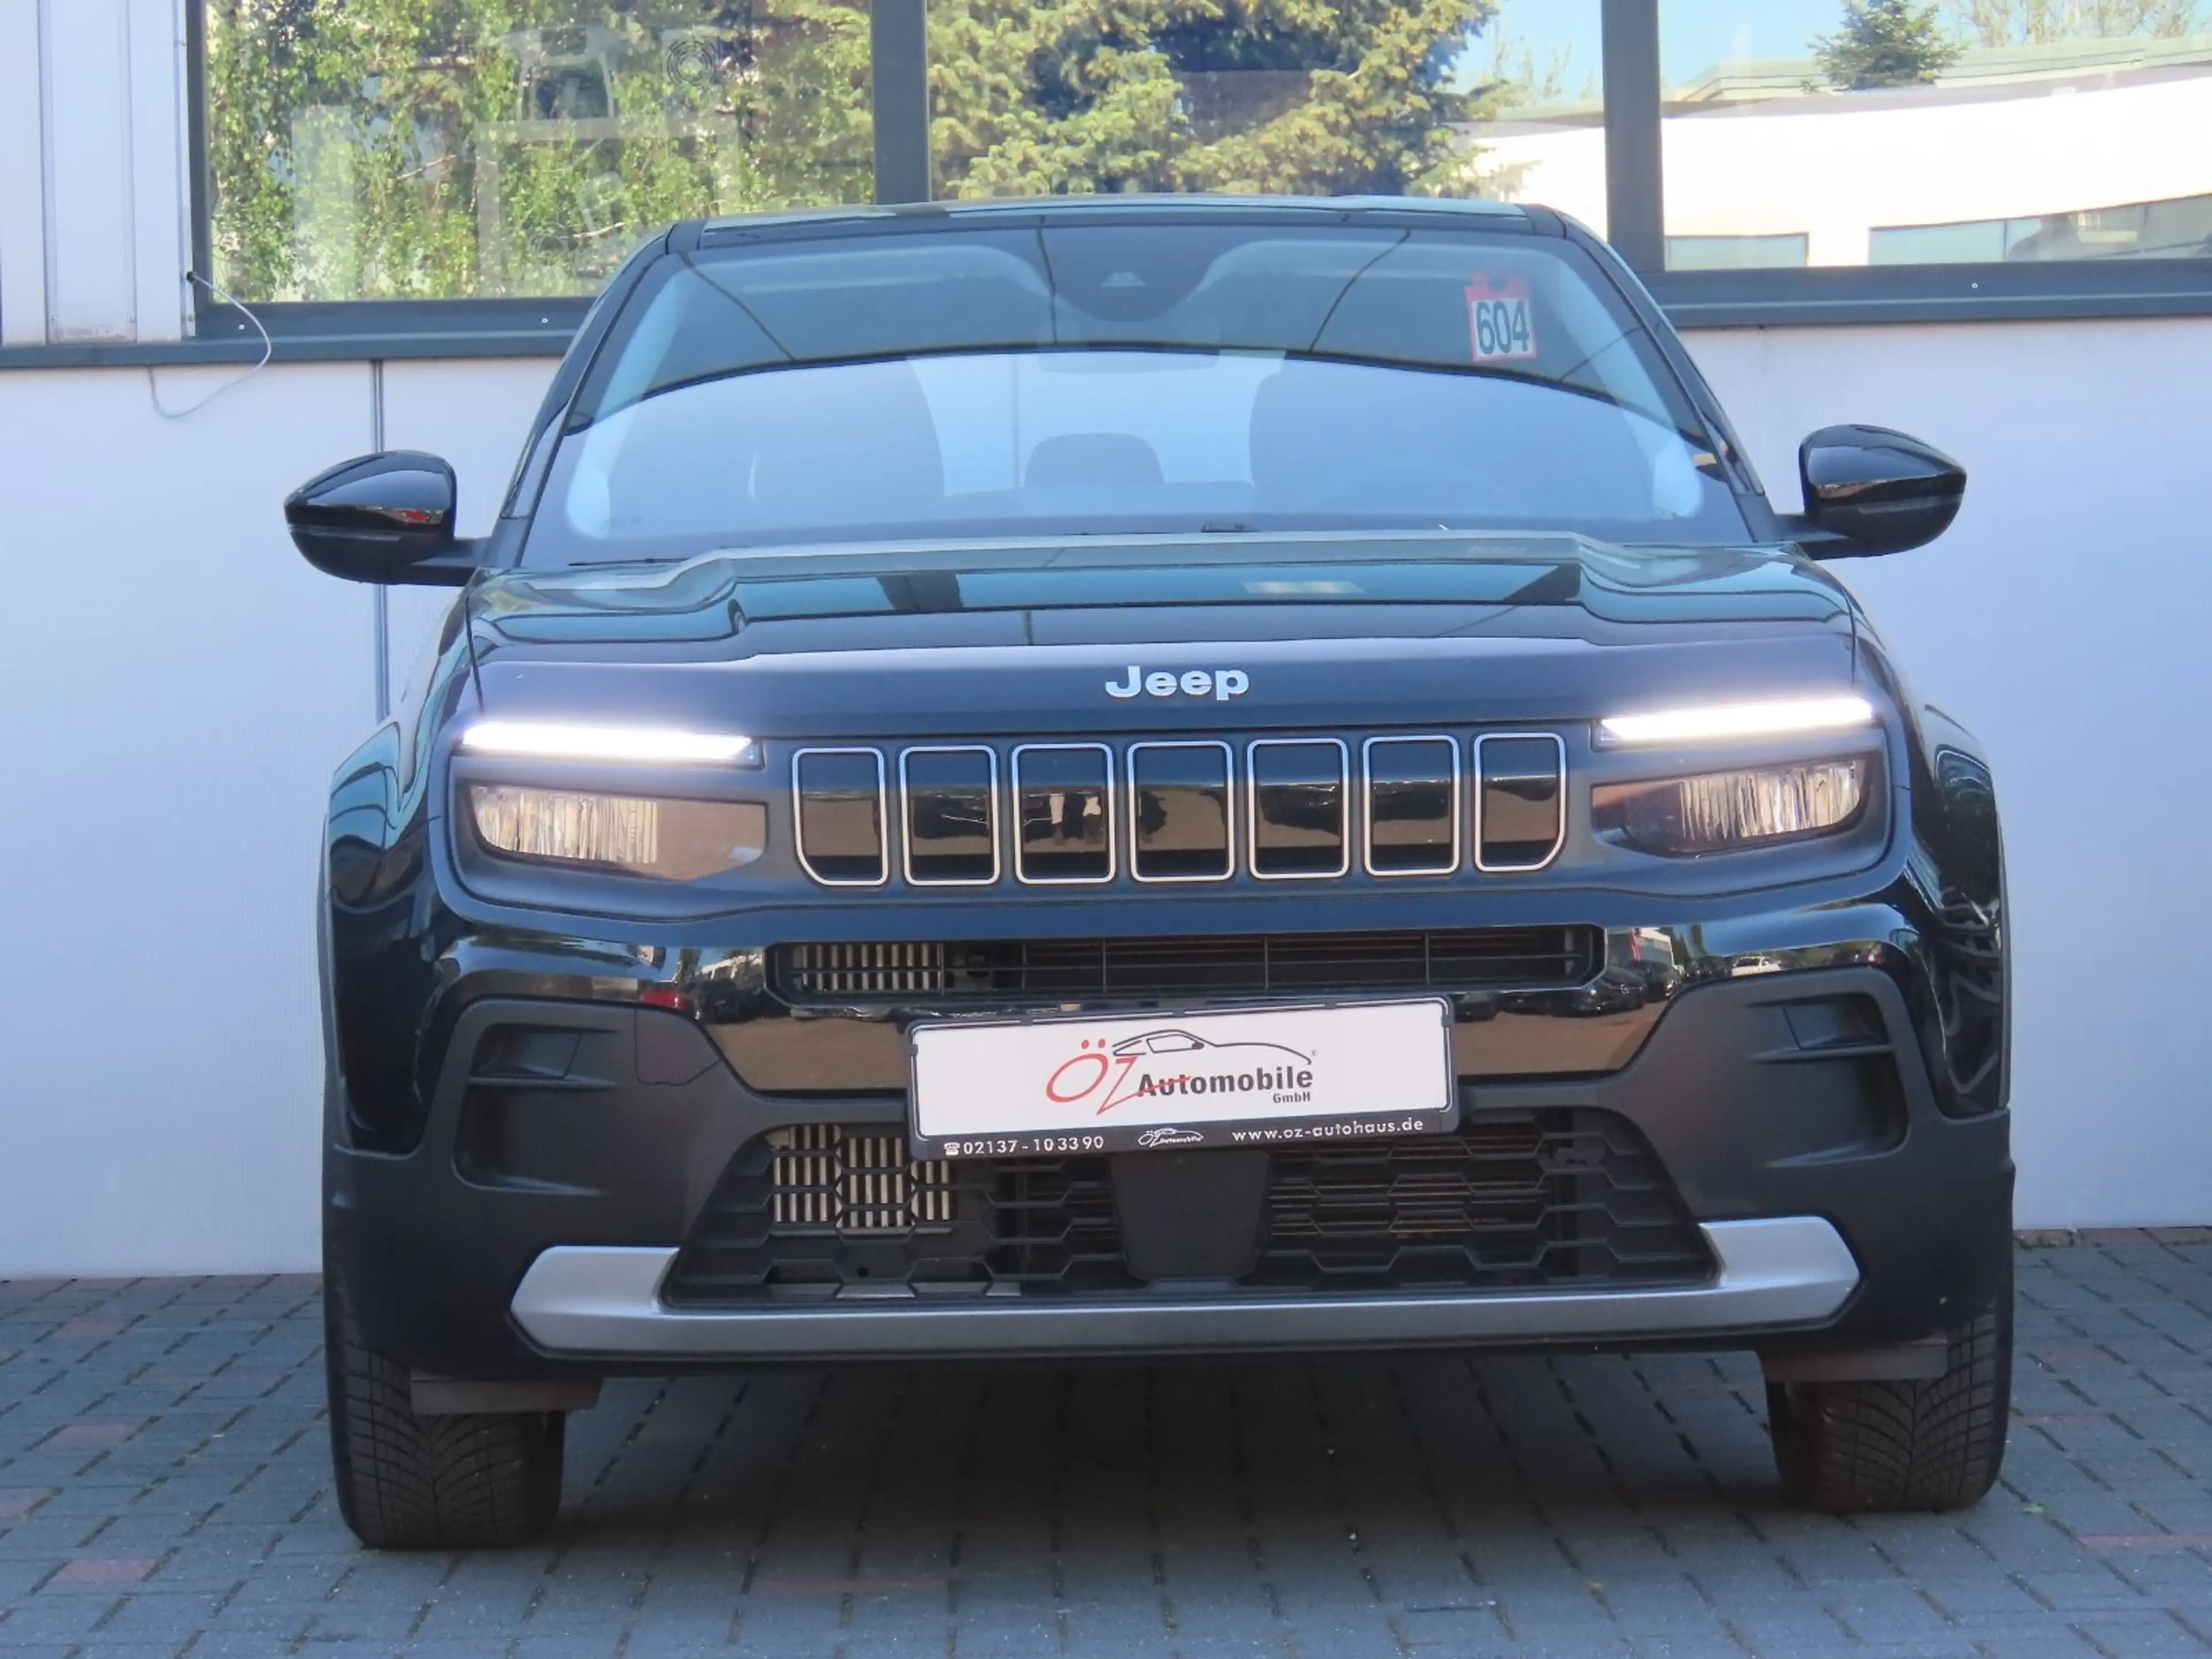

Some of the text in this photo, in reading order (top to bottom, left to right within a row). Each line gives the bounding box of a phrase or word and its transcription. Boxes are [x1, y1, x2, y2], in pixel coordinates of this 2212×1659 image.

[1476, 300, 1529, 355] 604
[1105, 665, 1249, 700] Jeep
[1046, 1038, 1313, 1115] ÖZ Automobile
[1272, 1092, 1311, 1104] GmbH
[1232, 1117, 1424, 1141] www.oz-autohaus.de
